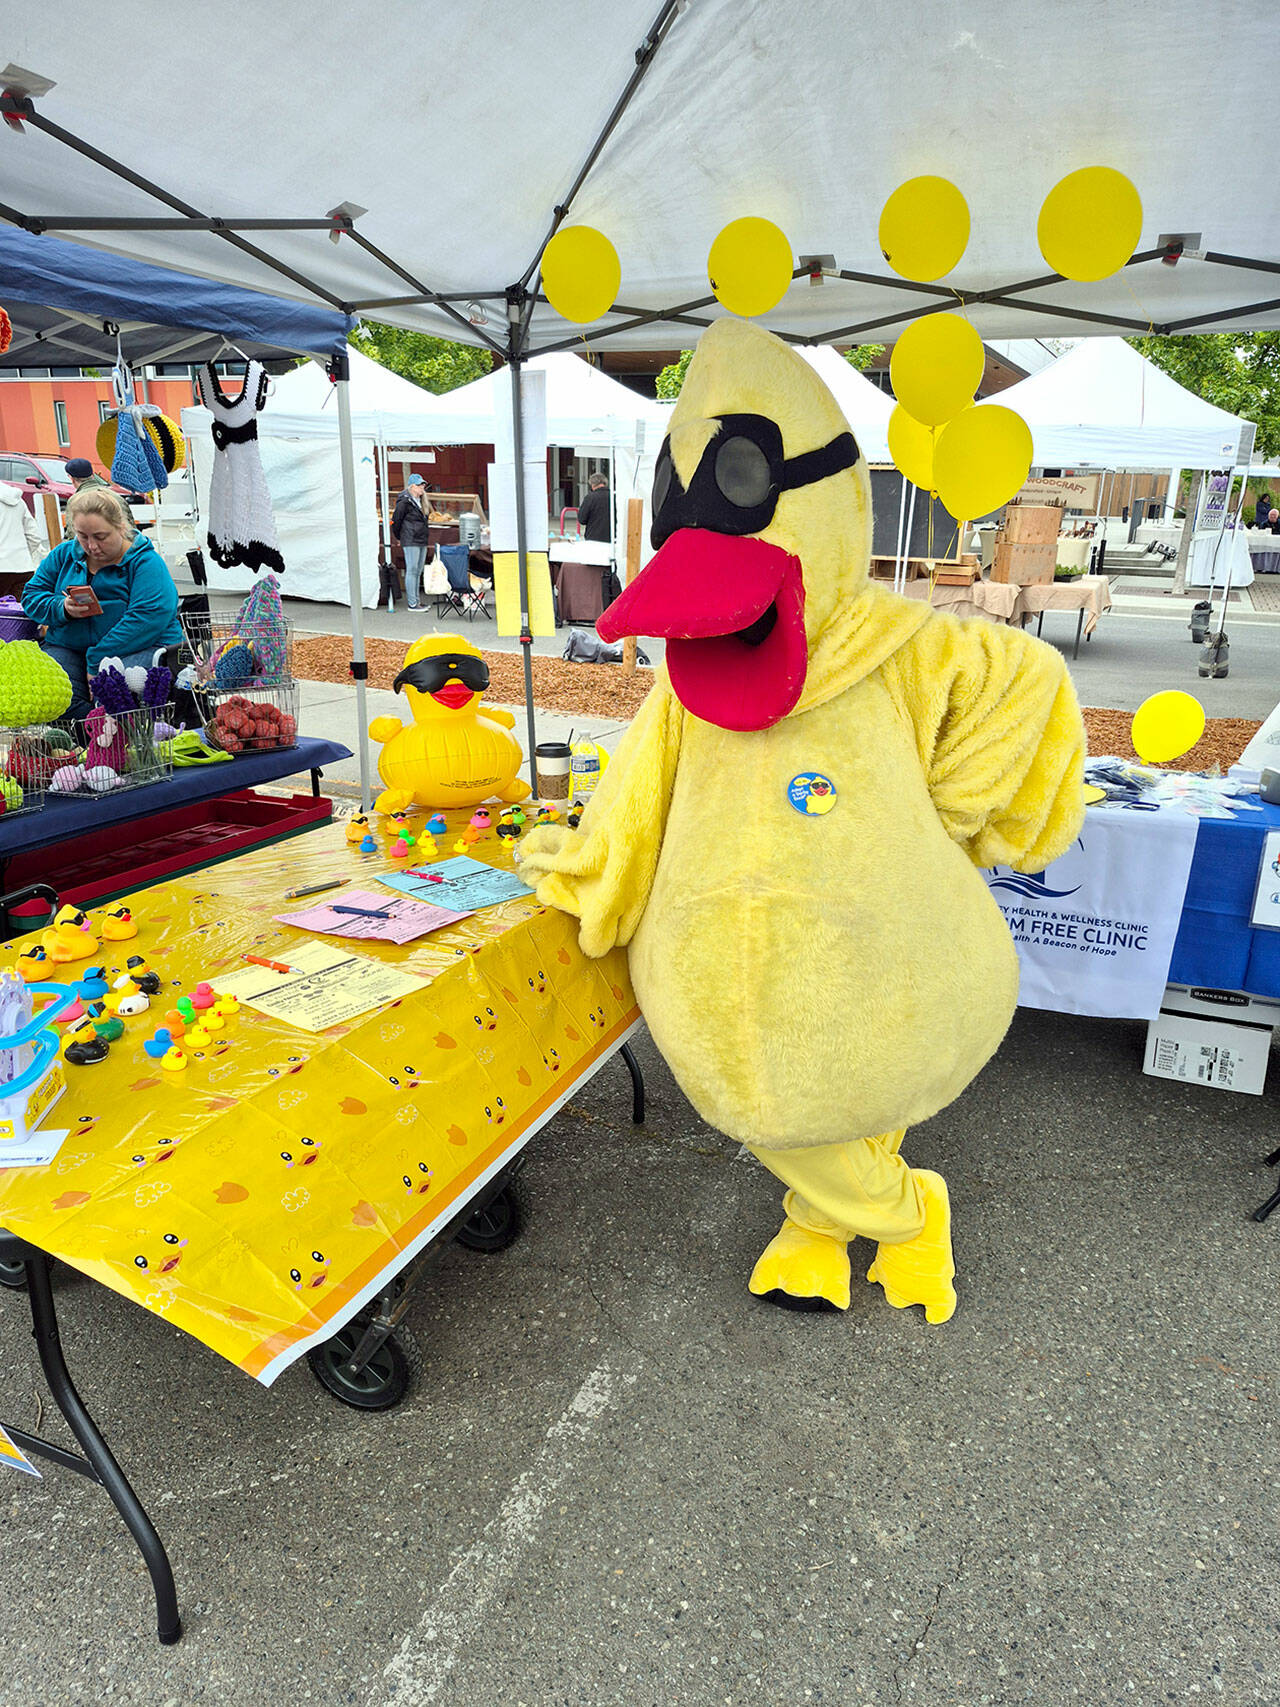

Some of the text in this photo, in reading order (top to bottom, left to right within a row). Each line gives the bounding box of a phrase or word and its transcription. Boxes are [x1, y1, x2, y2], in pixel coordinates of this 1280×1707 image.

[1027, 478, 1087, 494] WOODCRAFT
[1012, 907, 1048, 919] HEALTH
[1051, 912, 1058, 920] &
[1060, 913, 1112, 928] WELLNESS
[1114, 921, 1149, 934] CLINIC
[1005, 917, 1148, 951] M FREE CLINIC
[1033, 936, 1040, 944] A
[1042, 937, 1077, 949] Beacon
[1080, 945, 1091, 953] of
[1091, 946, 1117, 957] Hope
[1194, 990, 1245, 1004] BANKERS BOX
